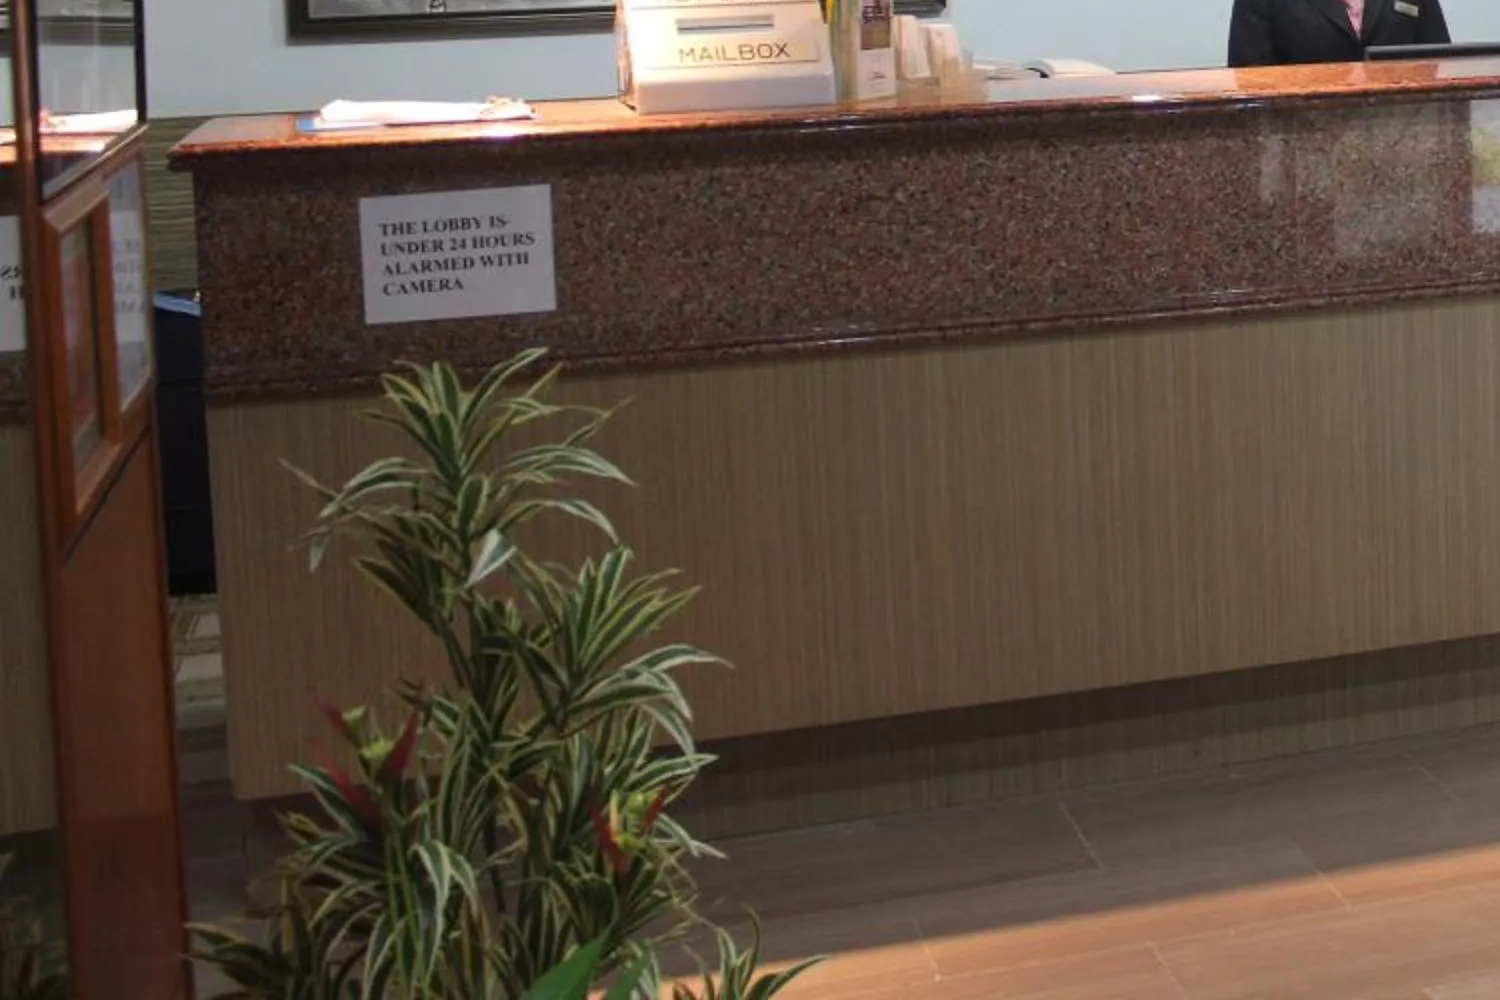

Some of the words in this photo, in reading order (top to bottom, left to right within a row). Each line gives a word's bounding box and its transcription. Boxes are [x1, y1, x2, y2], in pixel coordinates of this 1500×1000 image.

[678, 42, 791, 63] MAILBOX
[378, 221, 417, 236] THE
[422, 215, 482, 234] LOBBY
[381, 239, 444, 256] UNDER
[449, 236, 467, 250] 24
[471, 231, 536, 249] HOURS
[382, 256, 475, 276] ALARMED
[480, 251, 529, 267] WITH
[382, 276, 464, 296] CAMERA
